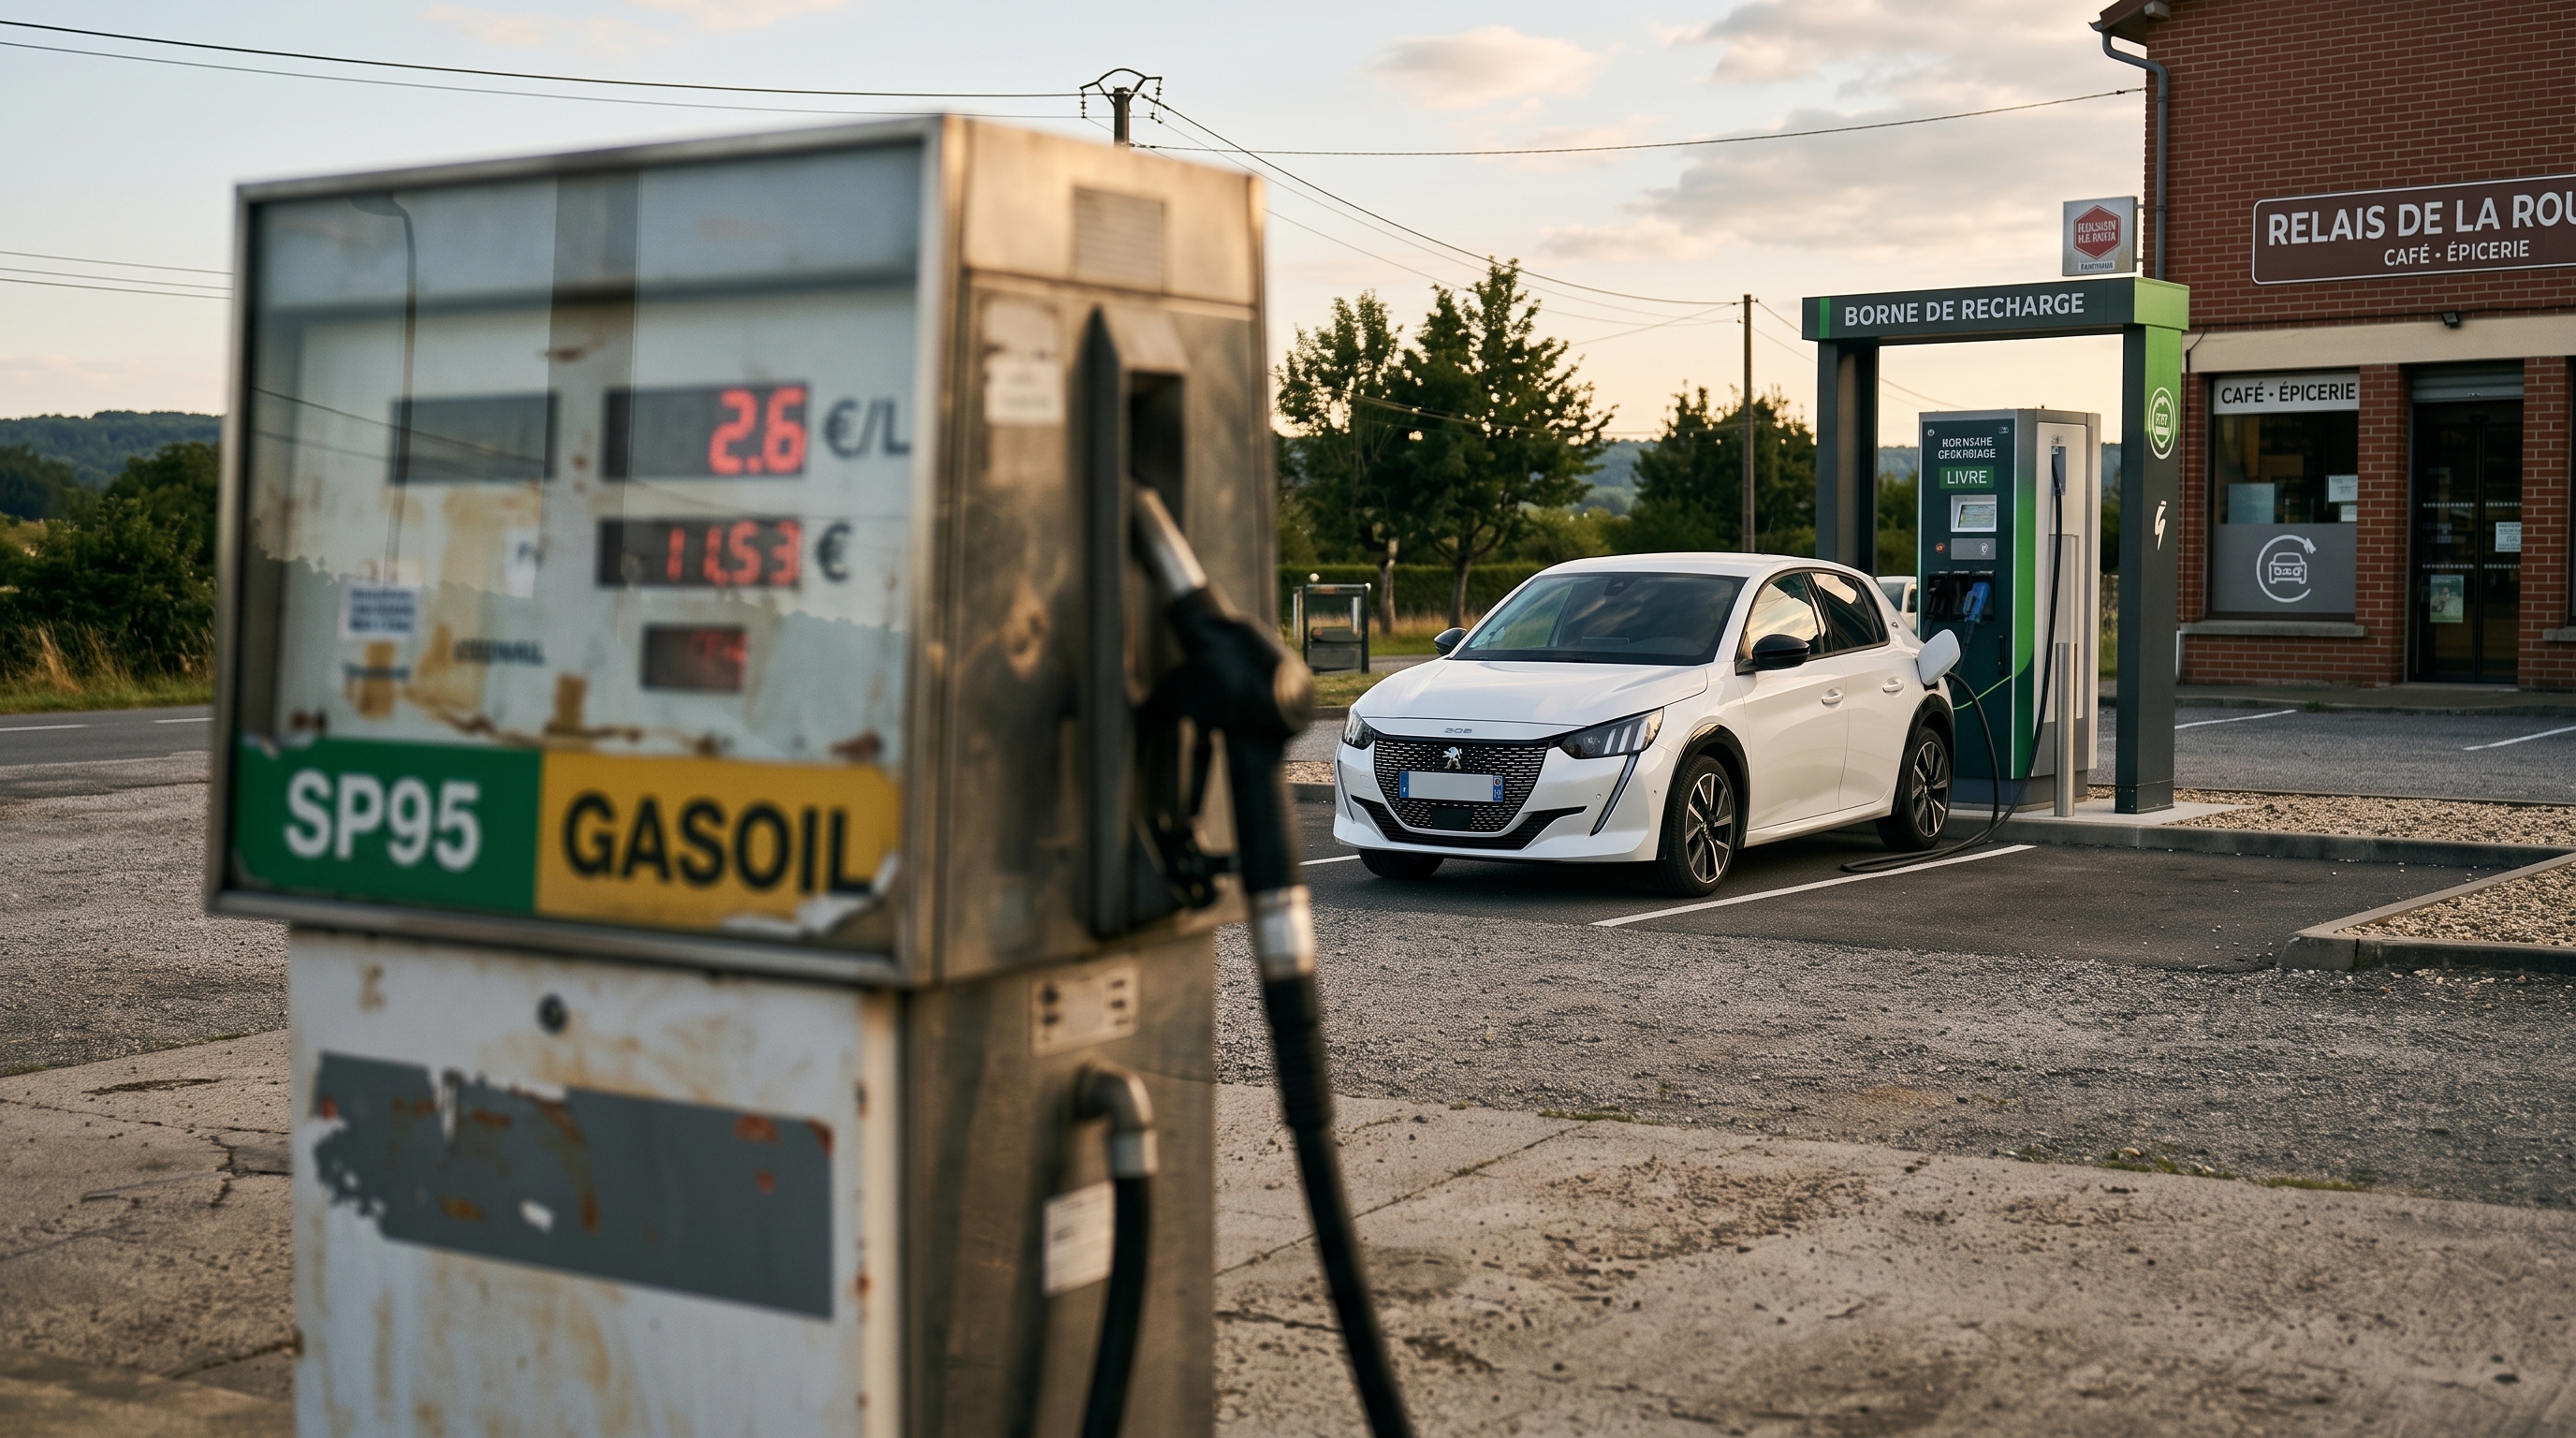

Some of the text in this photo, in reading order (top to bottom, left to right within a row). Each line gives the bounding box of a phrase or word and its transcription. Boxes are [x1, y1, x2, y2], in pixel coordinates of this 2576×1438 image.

[2268, 204, 2386, 246] RELAIS
[2397, 200, 2443, 237] DE
[2455, 197, 2501, 233] LA
[2384, 239, 2530, 267] CAFÉ ÉPICERIE
[1844, 292, 2085, 327] BORNE DE RECHARGE
[2221, 381, 2356, 404] CAFÉ ÉPICERIE
[708, 385, 912, 476] 2.6 €/L
[1947, 470, 1987, 485] LIVRE
[815, 521, 854, 584] €
[284, 770, 481, 872] SP95
[564, 789, 874, 895] GASOIL
